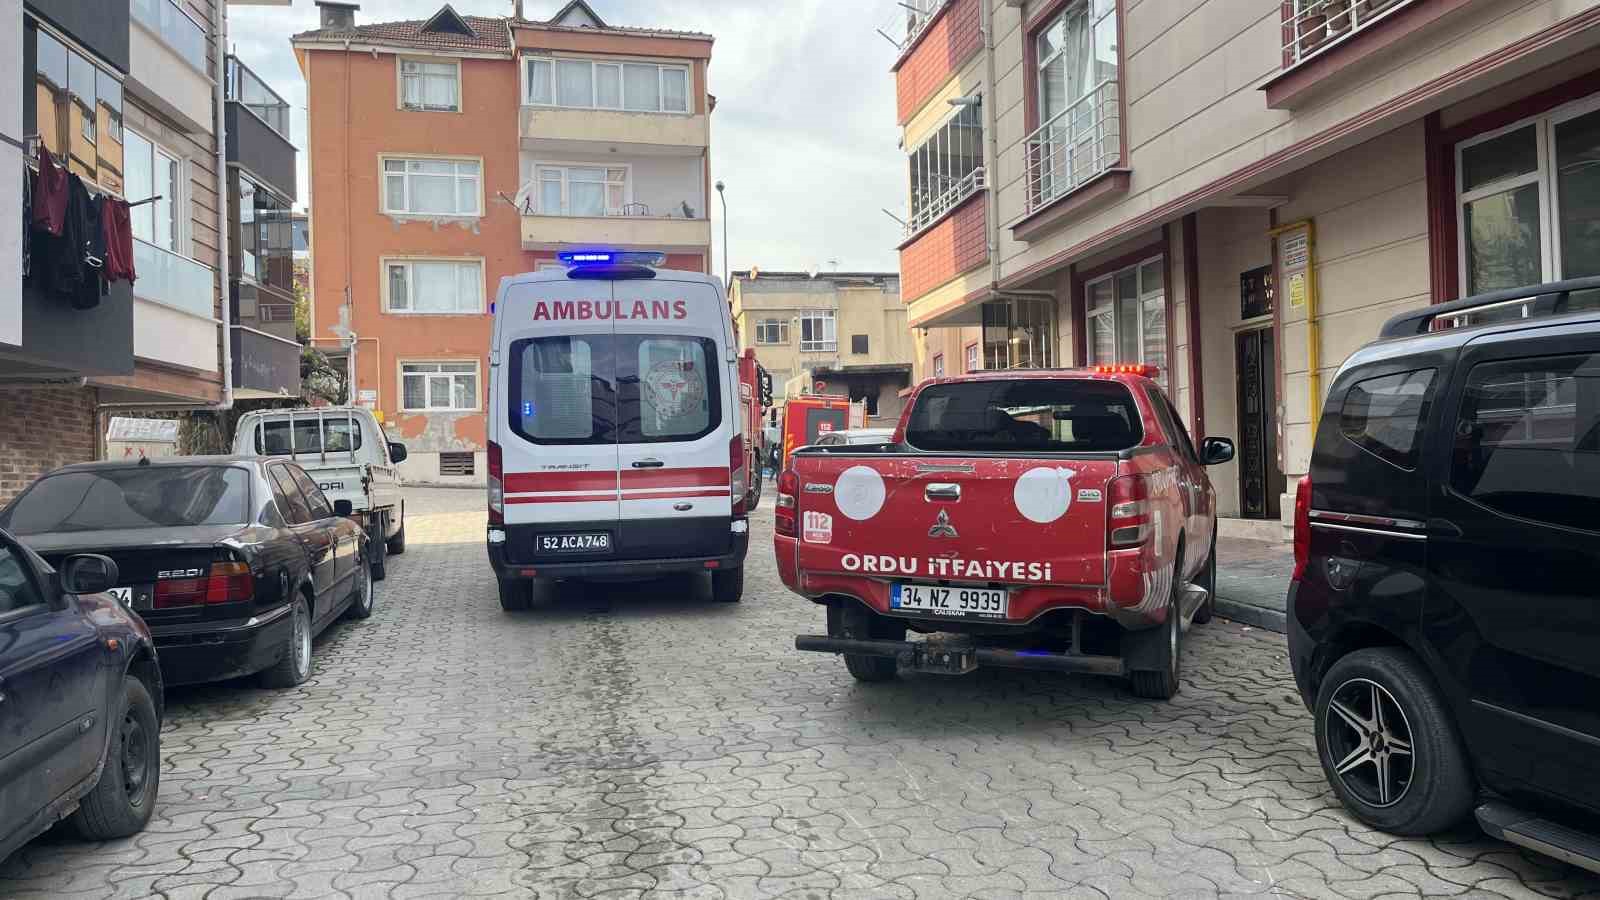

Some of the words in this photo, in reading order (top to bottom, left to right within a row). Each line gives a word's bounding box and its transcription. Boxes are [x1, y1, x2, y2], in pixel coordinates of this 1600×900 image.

[533, 300, 688, 321] AMBULANS
[807, 512, 831, 529] 112
[543, 537, 559, 549] 52
[561, 536, 584, 548] ACA
[585, 535, 607, 547] 748
[841, 553, 917, 574] ORDU
[903, 587, 922, 606] 34
[929, 588, 950, 608] NZ
[959, 590, 1001, 611] 9939
